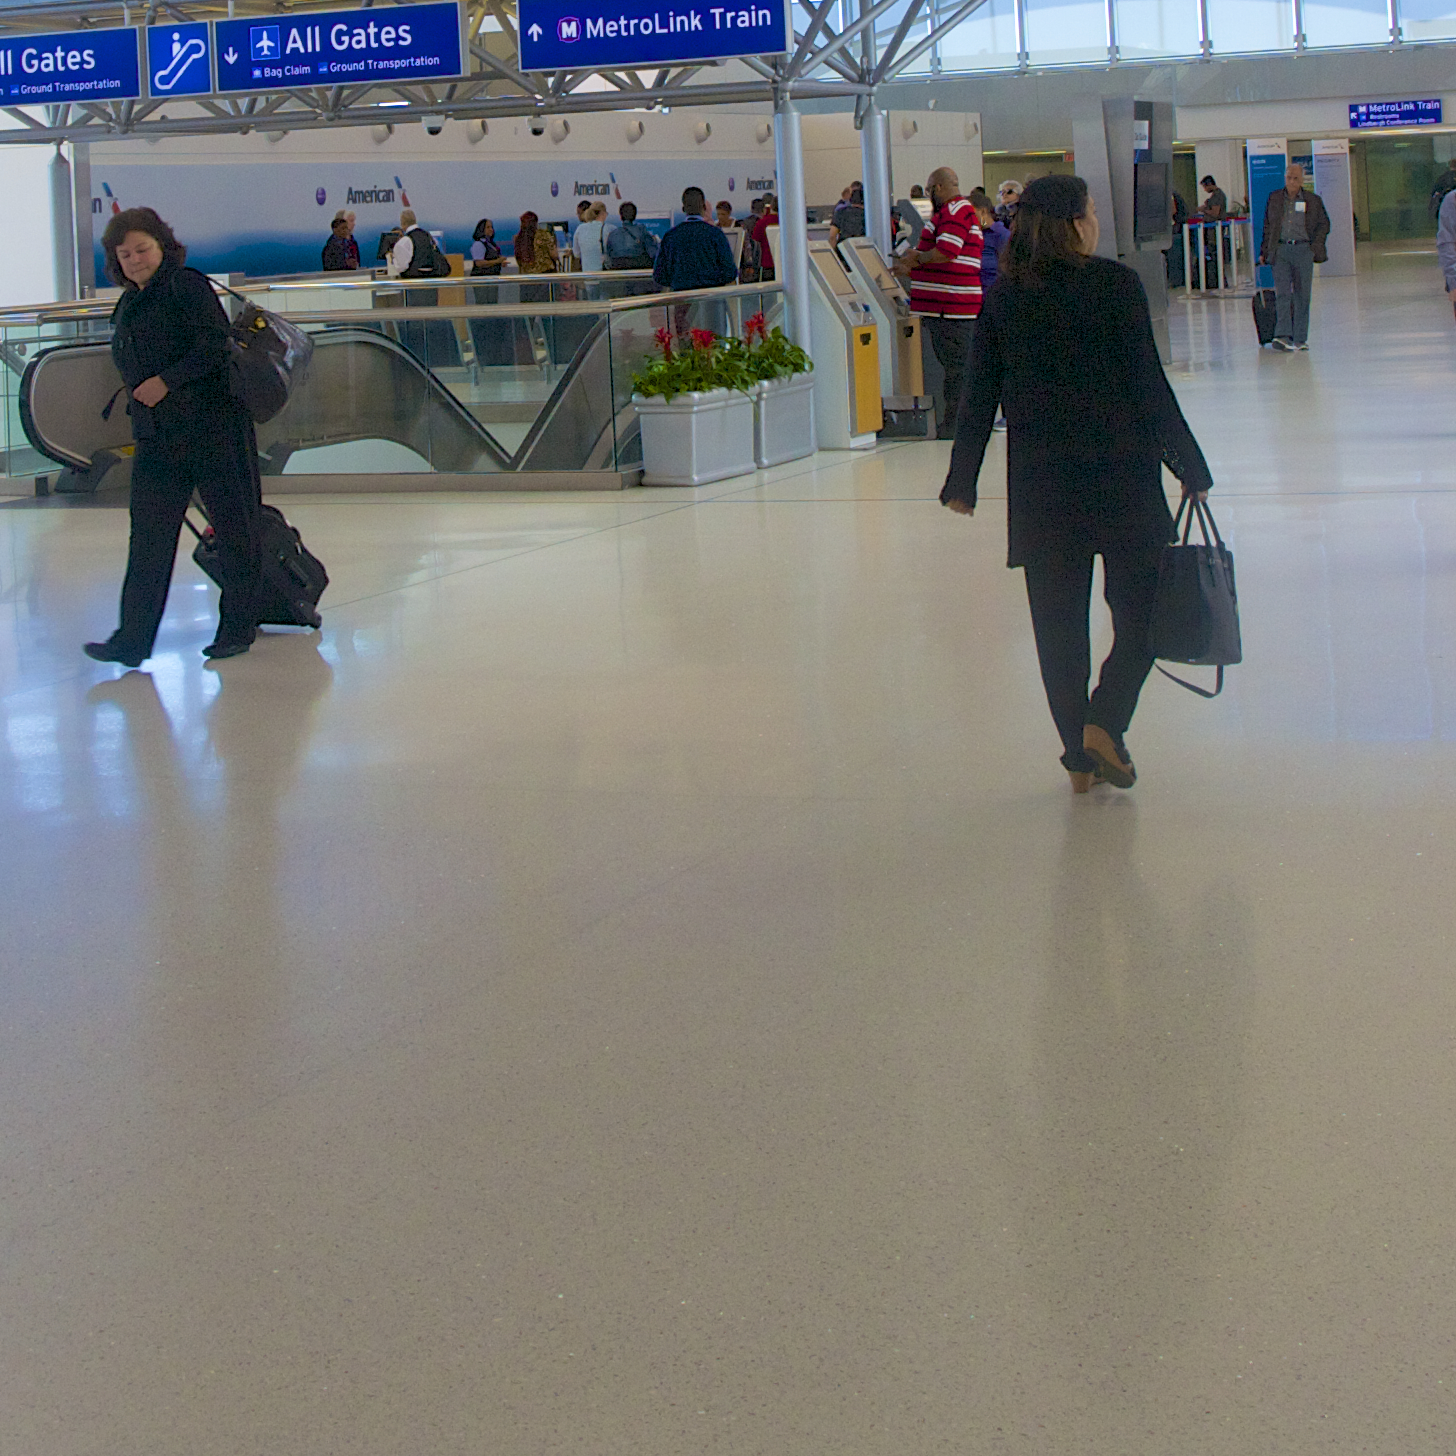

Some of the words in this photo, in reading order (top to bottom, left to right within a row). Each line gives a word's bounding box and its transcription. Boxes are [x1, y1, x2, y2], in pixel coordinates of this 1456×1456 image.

[561, 22, 577, 38] M
[586, 10, 703, 39] MetroLink
[710, 5, 771, 29] Train
[286, 26, 320, 54] All
[330, 22, 412, 51] Gates
[21, 46, 95, 73] Gates
[330, 61, 364, 72] Ground
[368, 56, 440, 70] Transportation
[264, 68, 282, 78] Bag
[285, 64, 310, 76] Claim
[21, 83, 52, 94] Ground
[54, 79, 120, 91] Transportation
[1369, 103, 1415, 112] MetroLink
[1417, 101, 1440, 110] Train
[574, 180, 610, 195] American
[747, 177, 774, 190] American
[347, 185, 394, 204] American
